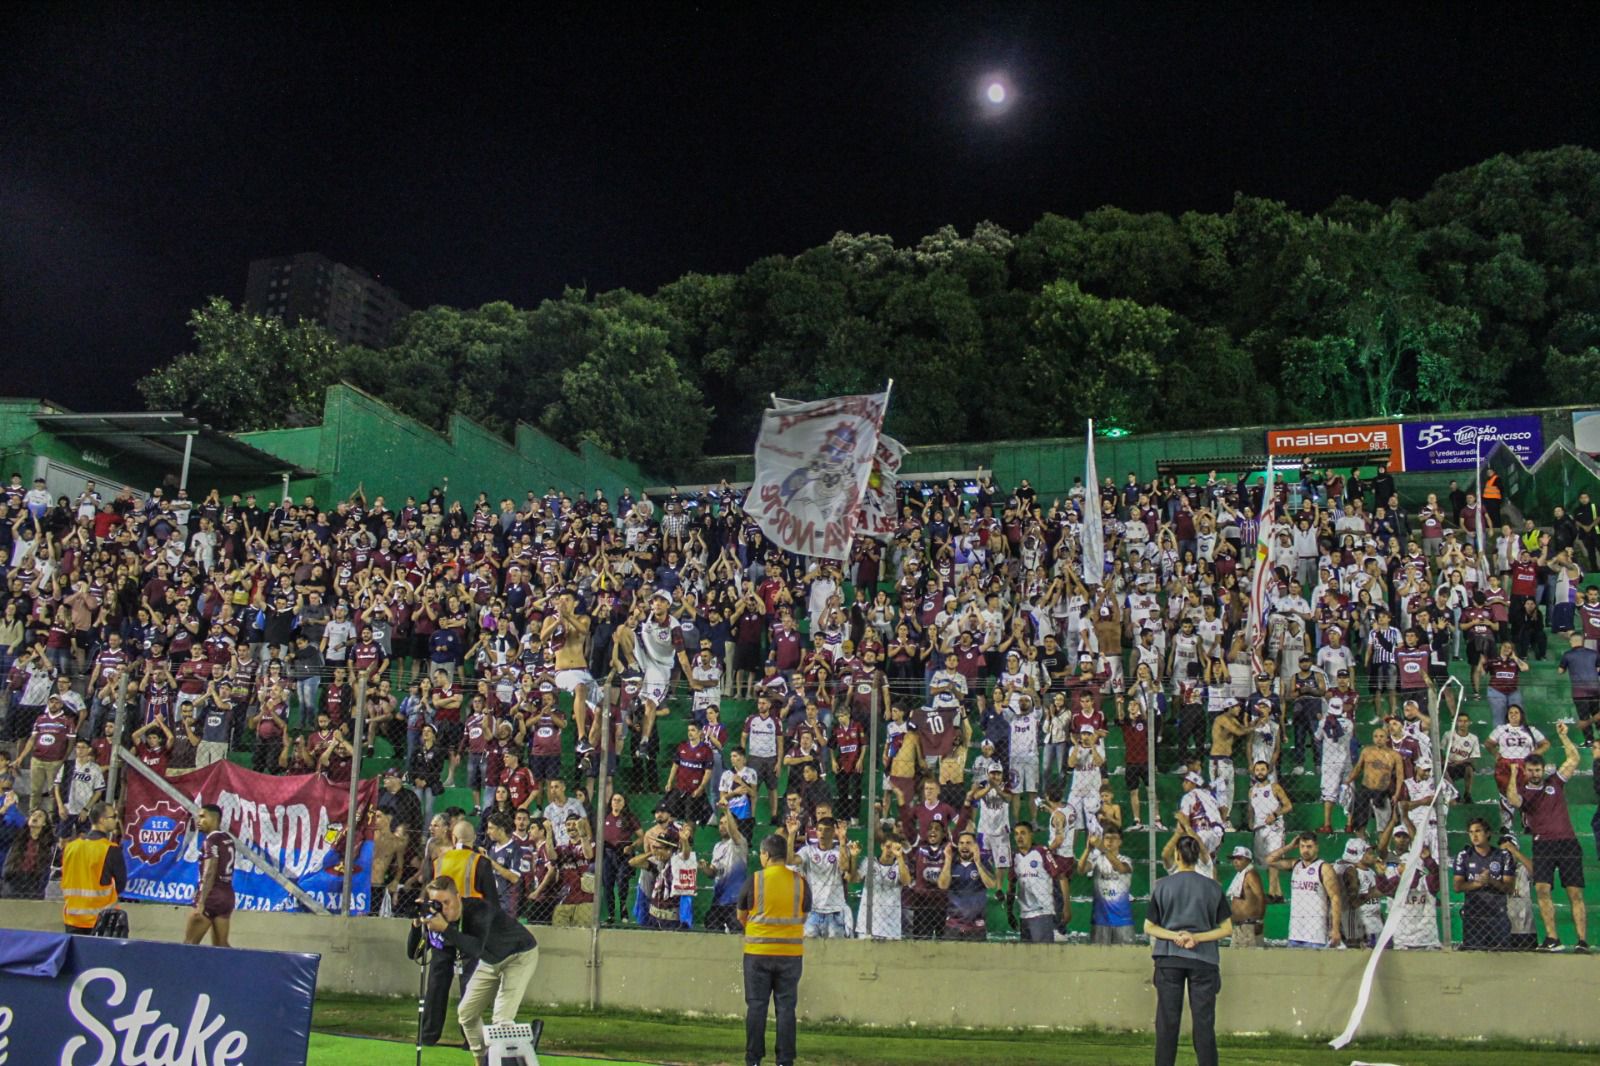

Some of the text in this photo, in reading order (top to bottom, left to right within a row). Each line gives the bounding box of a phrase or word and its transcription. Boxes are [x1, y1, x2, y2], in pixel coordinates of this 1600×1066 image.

[1419, 425, 1444, 444] 55
[1478, 425, 1497, 434] SÃO
[1478, 432, 1532, 441] FRANCISCO
[1276, 432, 1387, 447] maisnova
[1369, 442, 1388, 450] 98.5
[926, 716, 945, 735] 10
[124, 878, 196, 900] URRASCO
[61, 967, 248, 1066] Stake
